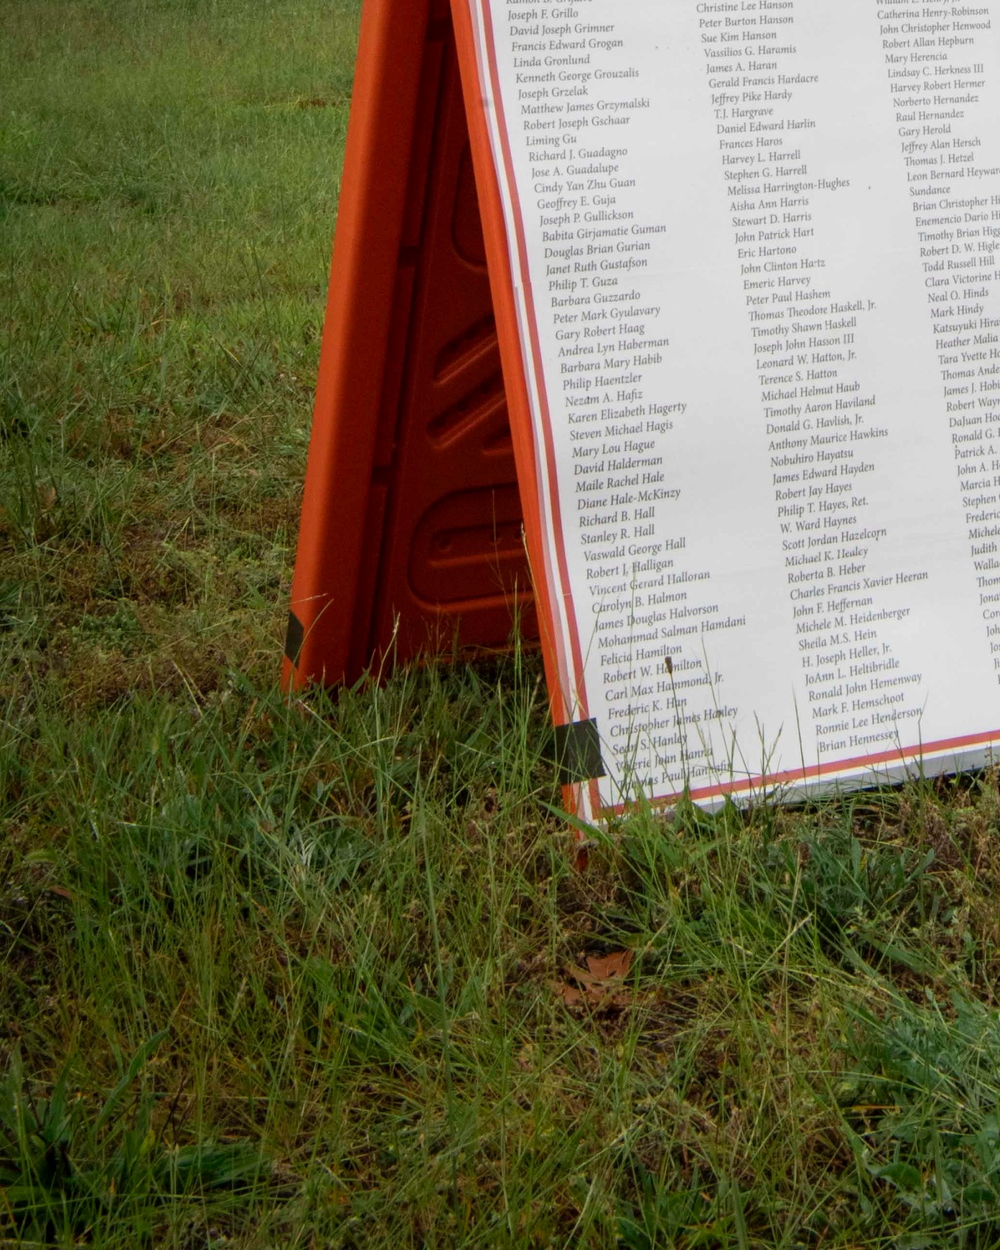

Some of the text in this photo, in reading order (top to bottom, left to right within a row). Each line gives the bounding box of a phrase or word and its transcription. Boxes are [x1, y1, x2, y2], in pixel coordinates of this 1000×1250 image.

[695, 0, 793, 13] Christine Lee Hanson
[876, 5, 989, 19] Catherina Henry-Robinson
[509, 22, 615, 37] David Joseph Grimner
[515, 66, 639, 83] Kenneth George Grouzalis
[708, 72, 819, 88] Gerald Francis Hardacre
[890, 79, 985, 94] Harvey Robert Hermer
[520, 97, 650, 114] Matthew James Grzymalski
[716, 117, 816, 134] Daniel Edward Harlin
[901, 136, 981, 154] Jeffrey Alan Hersch
[906, 171, 928, 181] Leon
[930, 166, 964, 180] Bernard
[533, 177, 636, 195] Cindy Yan Zhu Guan
[727, 176, 850, 196] Melissa Harrington-Hughes
[915, 213, 962, 227] Enemencio
[963, 211, 988, 222] Dario
[542, 224, 666, 242] Babita Girjamatie Guman
[734, 226, 814, 244] John Patrick Hart
[545, 256, 647, 276] Janet Ruth Gustafson
[924, 276, 949, 287] Clara
[951, 272, 992, 284] Victorine
[551, 289, 641, 307] Barbara Guzzardo
[746, 288, 831, 306] Peter Paul Hashem
[557, 338, 669, 357] Andrea Lyn Haberman
[753, 332, 854, 355] Joseph John Hasson III
[940, 369, 975, 380] Thomas
[567, 402, 687, 424] Karen Elizabeth Hagerty
[763, 393, 876, 418] Timothy Aaron Haviland
[946, 399, 975, 412] Robert
[768, 426, 888, 451] Anthony Maurice Hawkins
[573, 456, 662, 475] David Halderman
[772, 461, 875, 485] James Edward Hayden
[577, 488, 681, 510] Diane Hale-McKinzy
[962, 493, 996, 509] Stephen
[779, 515, 857, 533] W. Ward Haynes
[583, 536, 686, 561] Vaswald George Hall
[970, 541, 997, 557] Judith
[789, 571, 928, 600] Charles Francis Xavier Heeran
[795, 607, 910, 634] Michele M. Heidenberger
[808, 673, 922, 702] Ronald John Hemenway
